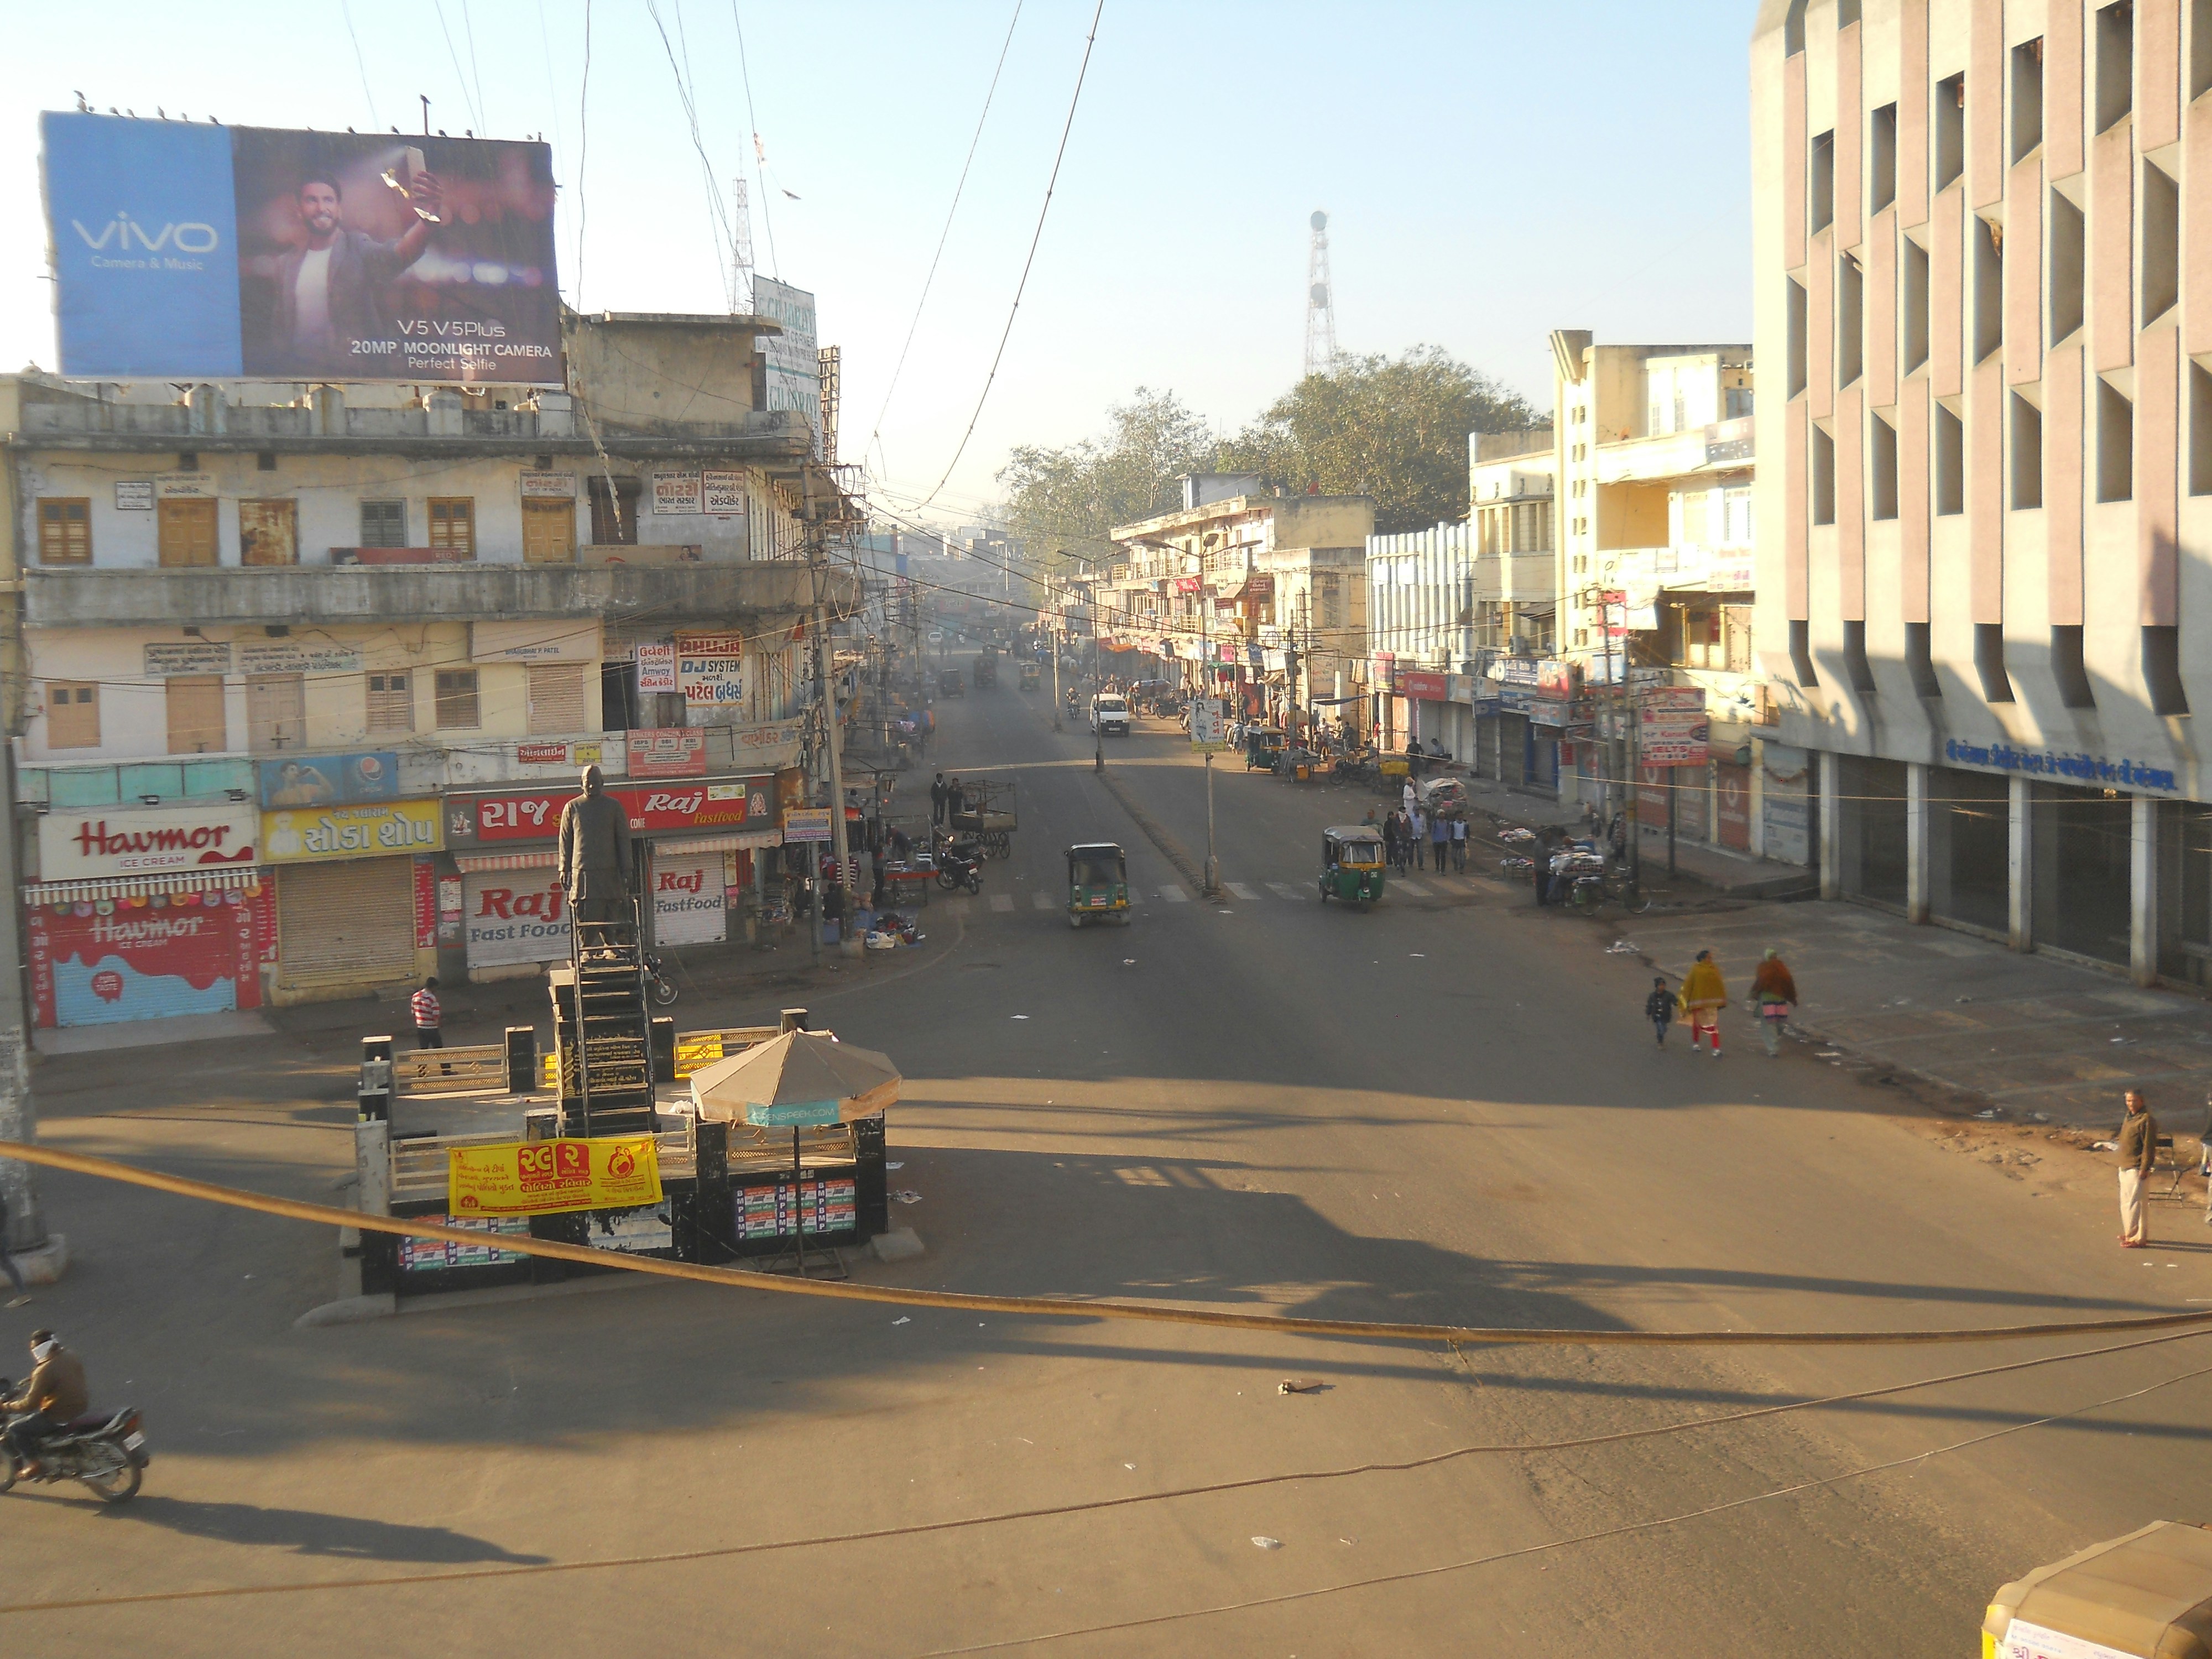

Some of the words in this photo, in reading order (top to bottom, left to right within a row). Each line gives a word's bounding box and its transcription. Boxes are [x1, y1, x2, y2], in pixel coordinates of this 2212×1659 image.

[72, 211, 218, 253] vivo
[91, 255, 145, 268] Camera
[150, 257, 160, 268] &
[165, 258, 203, 270] Music
[397, 320, 429, 335] V5
[790, 332, 815, 348] CORNER
[351, 341, 397, 354] 20MP
[404, 342, 492, 356] MOONLIGHT
[494, 344, 552, 357] CAMERA
[408, 357, 455, 369] Perfect
[460, 358, 497, 371] Selfie
[679, 639, 740, 653] AHUJA
[641, 666, 671, 676] Amway
[681, 660, 706, 674] DJ
[708, 660, 740, 672] SYSTEM
[685, 681, 714, 700] પટેલ
[644, 791, 703, 814] Raj
[482, 800, 551, 828] રાજ
[693, 811, 743, 824] Fastfood
[71, 821, 231, 856] Havmor
[305, 817, 371, 852] સોડા
[378, 811, 434, 847] શોપ
[120, 859, 138, 868] ICE
[142, 856, 185, 867] CREAM
[658, 869, 703, 894] Raj
[474, 882, 563, 922] Raj
[656, 895, 722, 913] Fastfood
[88, 916, 204, 943] Havmor
[471, 925, 515, 942] Fast
[520, 1146, 552, 1172] ૨૯
[565, 1145, 580, 1167] ૨
[521, 1181, 556, 1192] પોલિયો
[559, 1178, 591, 1189] રવિવાર
